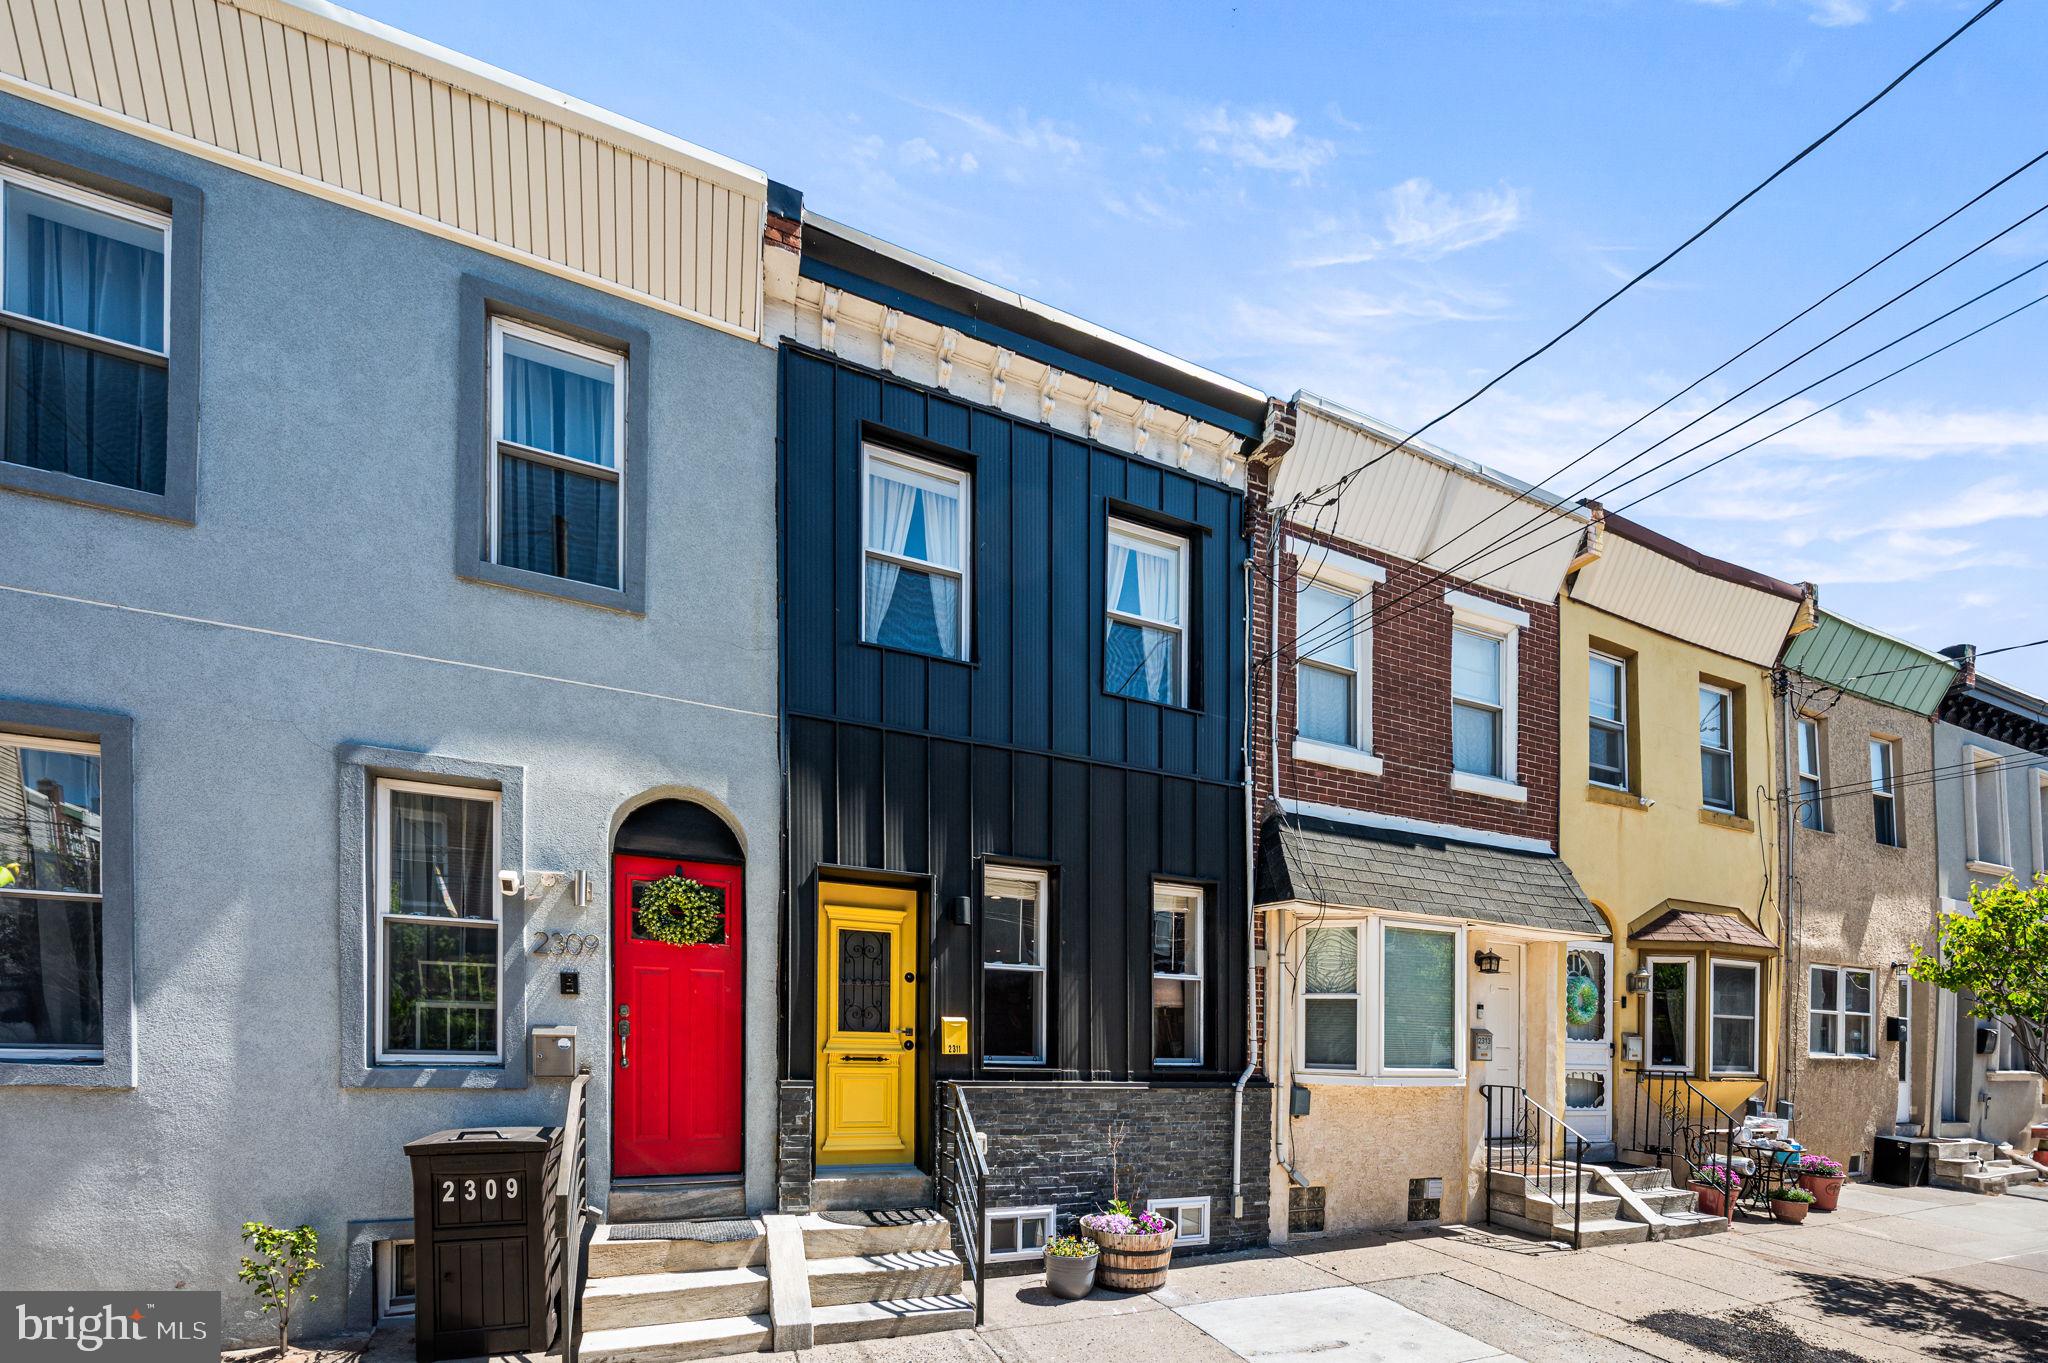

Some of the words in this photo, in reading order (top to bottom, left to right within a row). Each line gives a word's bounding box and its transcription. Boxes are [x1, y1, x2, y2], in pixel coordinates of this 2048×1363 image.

[533, 931, 599, 957] 2309
[948, 1044, 961, 1053] 2311
[442, 1178, 518, 1203] 2309
